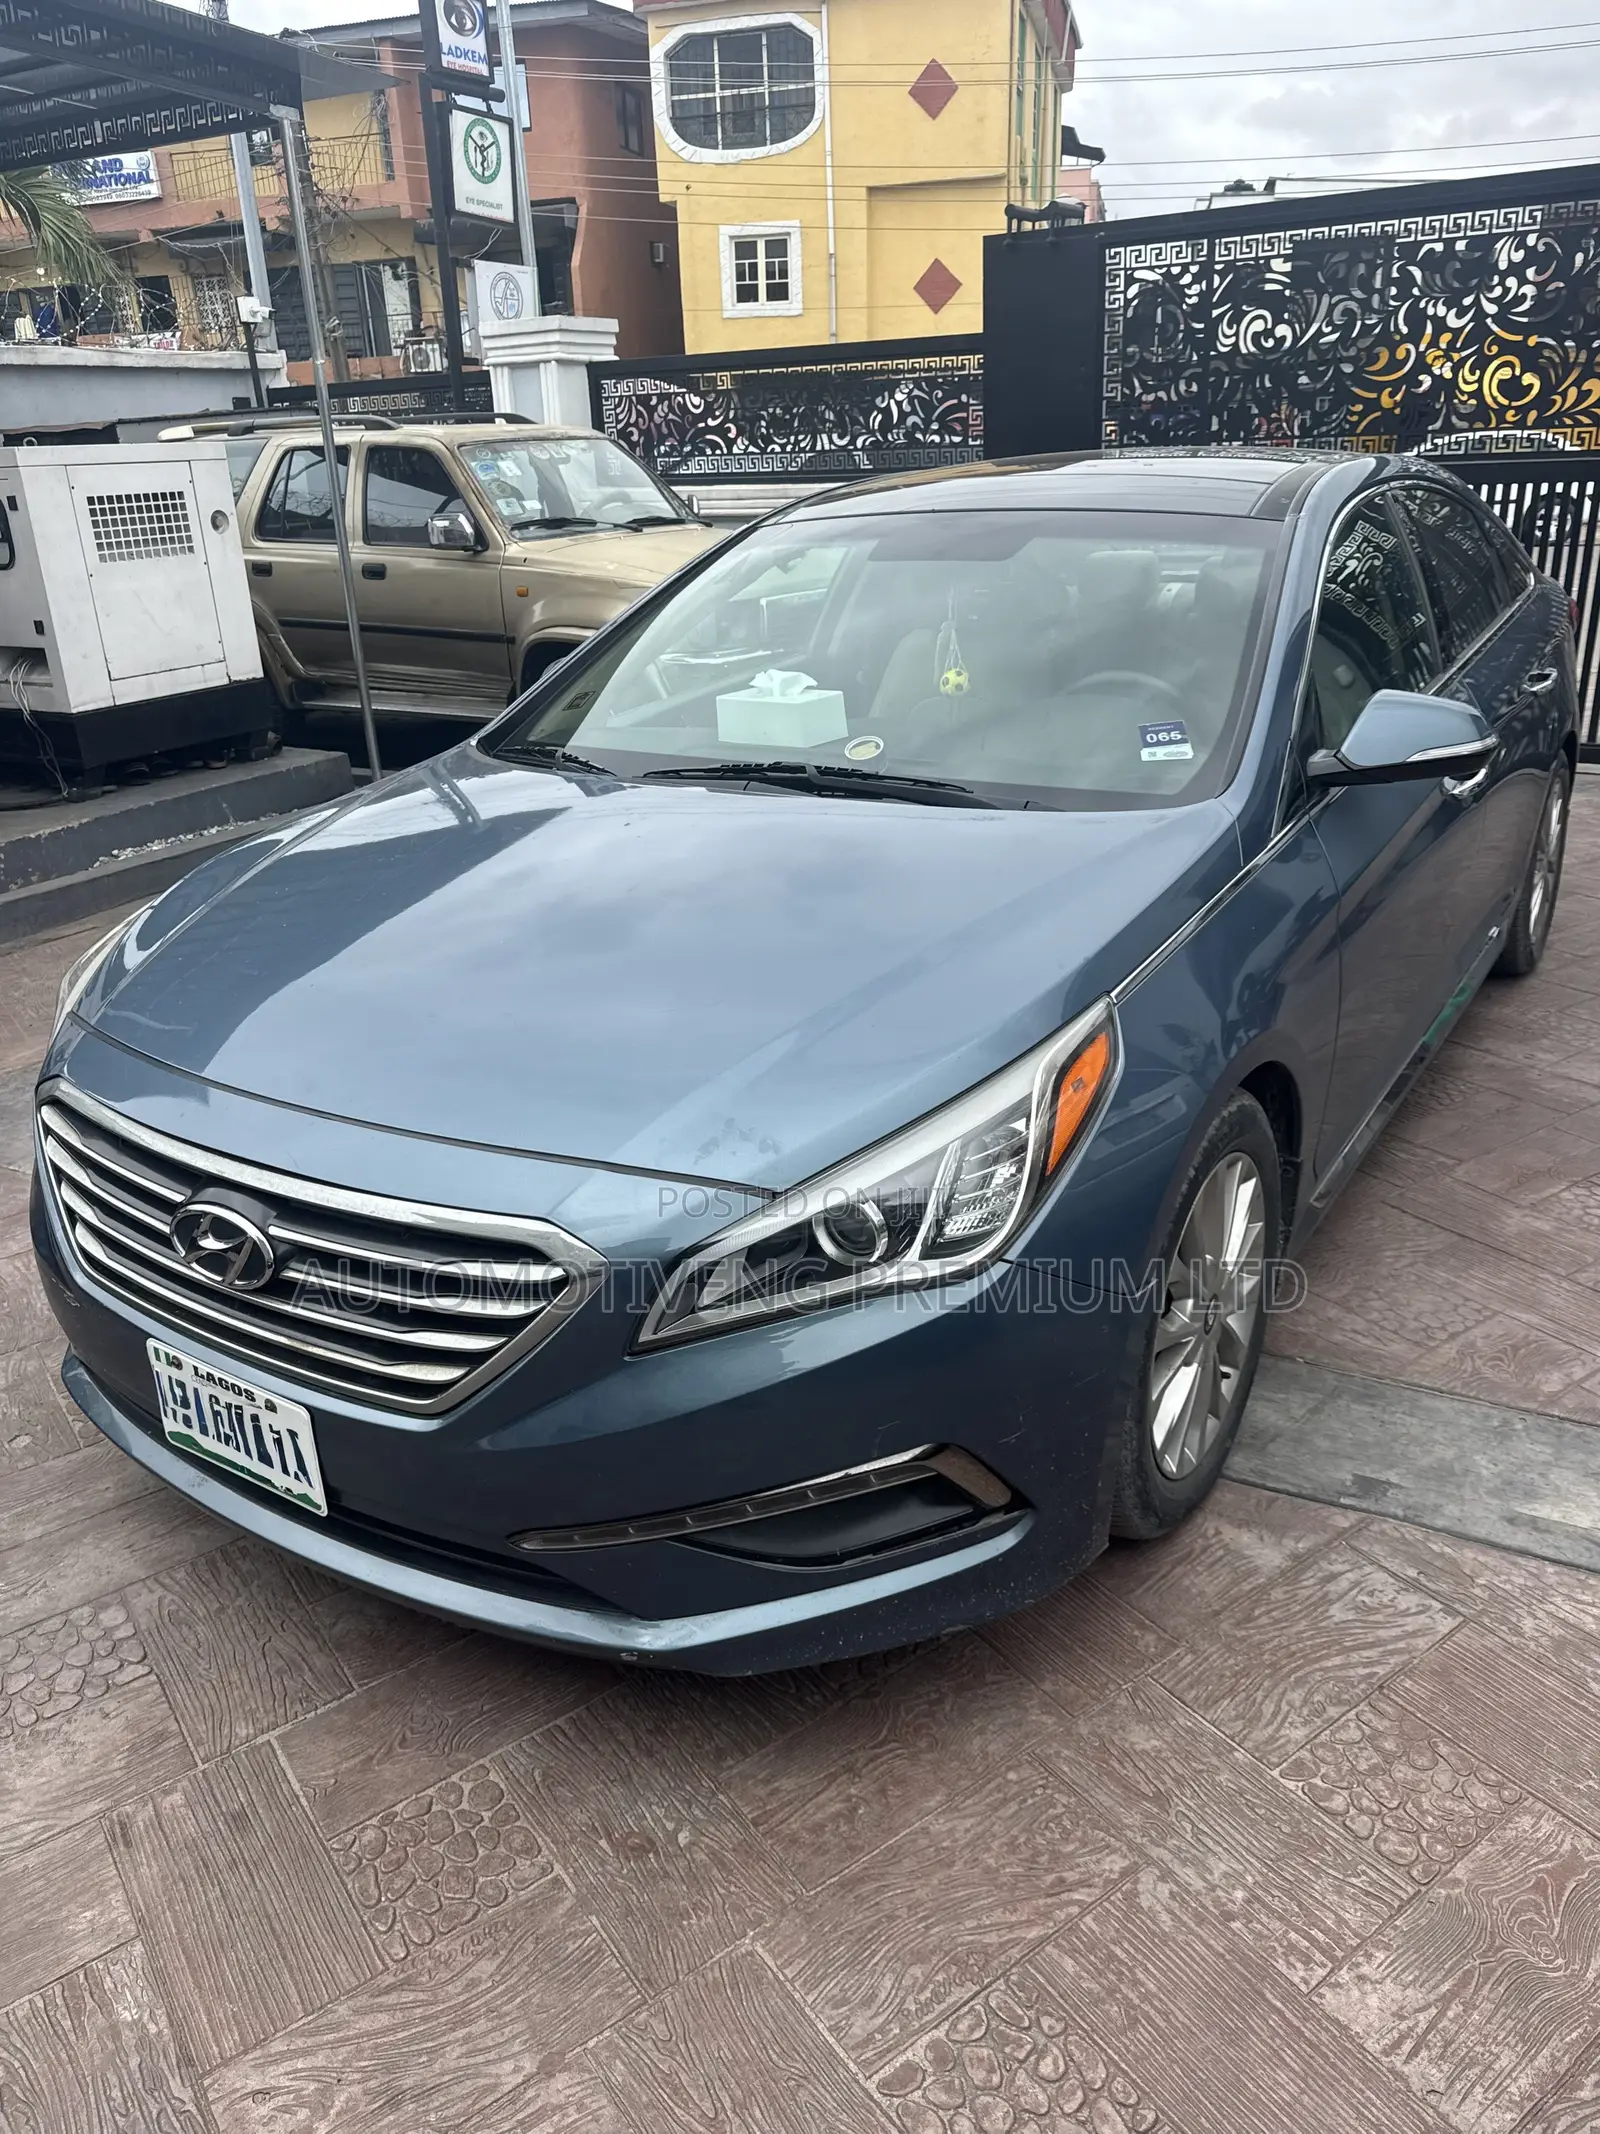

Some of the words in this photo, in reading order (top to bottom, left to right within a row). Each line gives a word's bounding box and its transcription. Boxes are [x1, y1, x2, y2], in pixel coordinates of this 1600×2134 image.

[440, 42, 488, 66] LADKEM
[447, 60, 456, 69] EYE
[457, 63, 482, 75] HOSPITAL
[465, 196, 475, 206] EYE
[476, 198, 503, 210] SPECIALIST
[1145, 730, 1182, 743] 065
[192, 1365, 256, 1403] LAGOS
